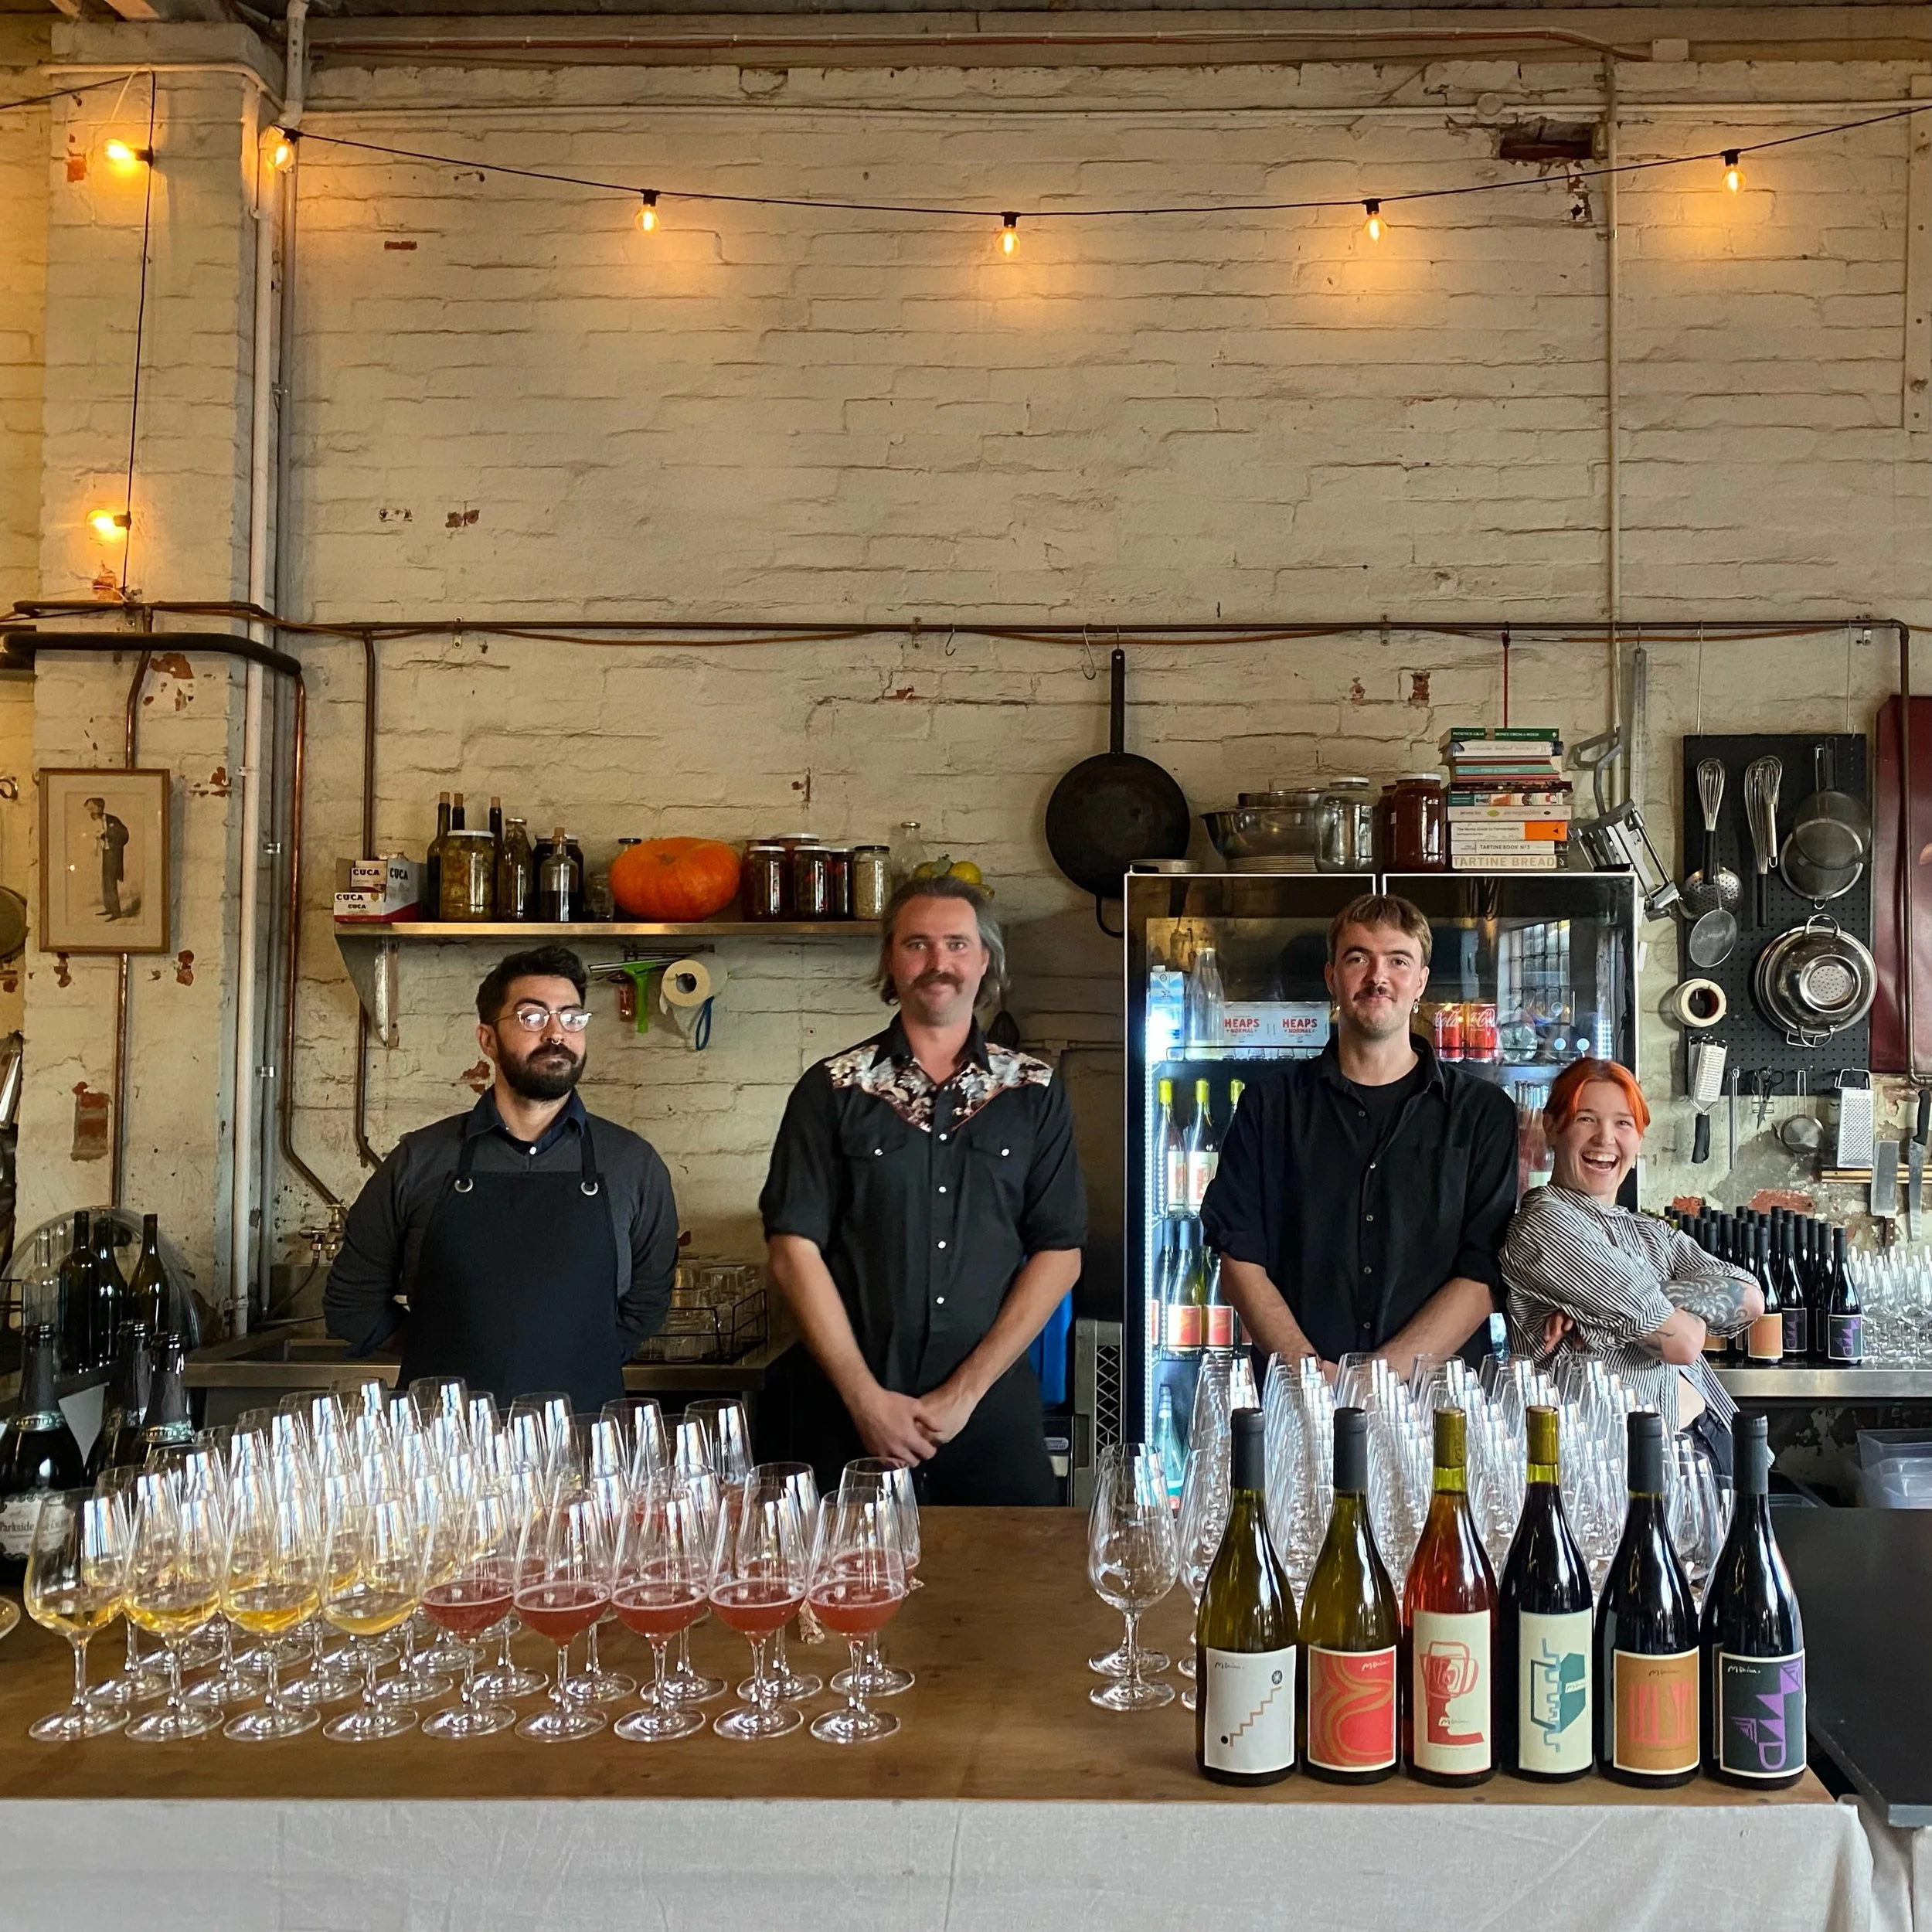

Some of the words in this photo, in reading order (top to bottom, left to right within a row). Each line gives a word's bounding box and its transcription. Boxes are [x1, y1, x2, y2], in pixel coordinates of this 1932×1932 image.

[1454, 857, 1507, 866] TARTINE
[1512, 856, 1555, 866] BREAD
[389, 867, 408, 880] CUCA
[1224, 1019, 1260, 1028] HEAPS
[1282, 1019, 1318, 1028] HEAPS
